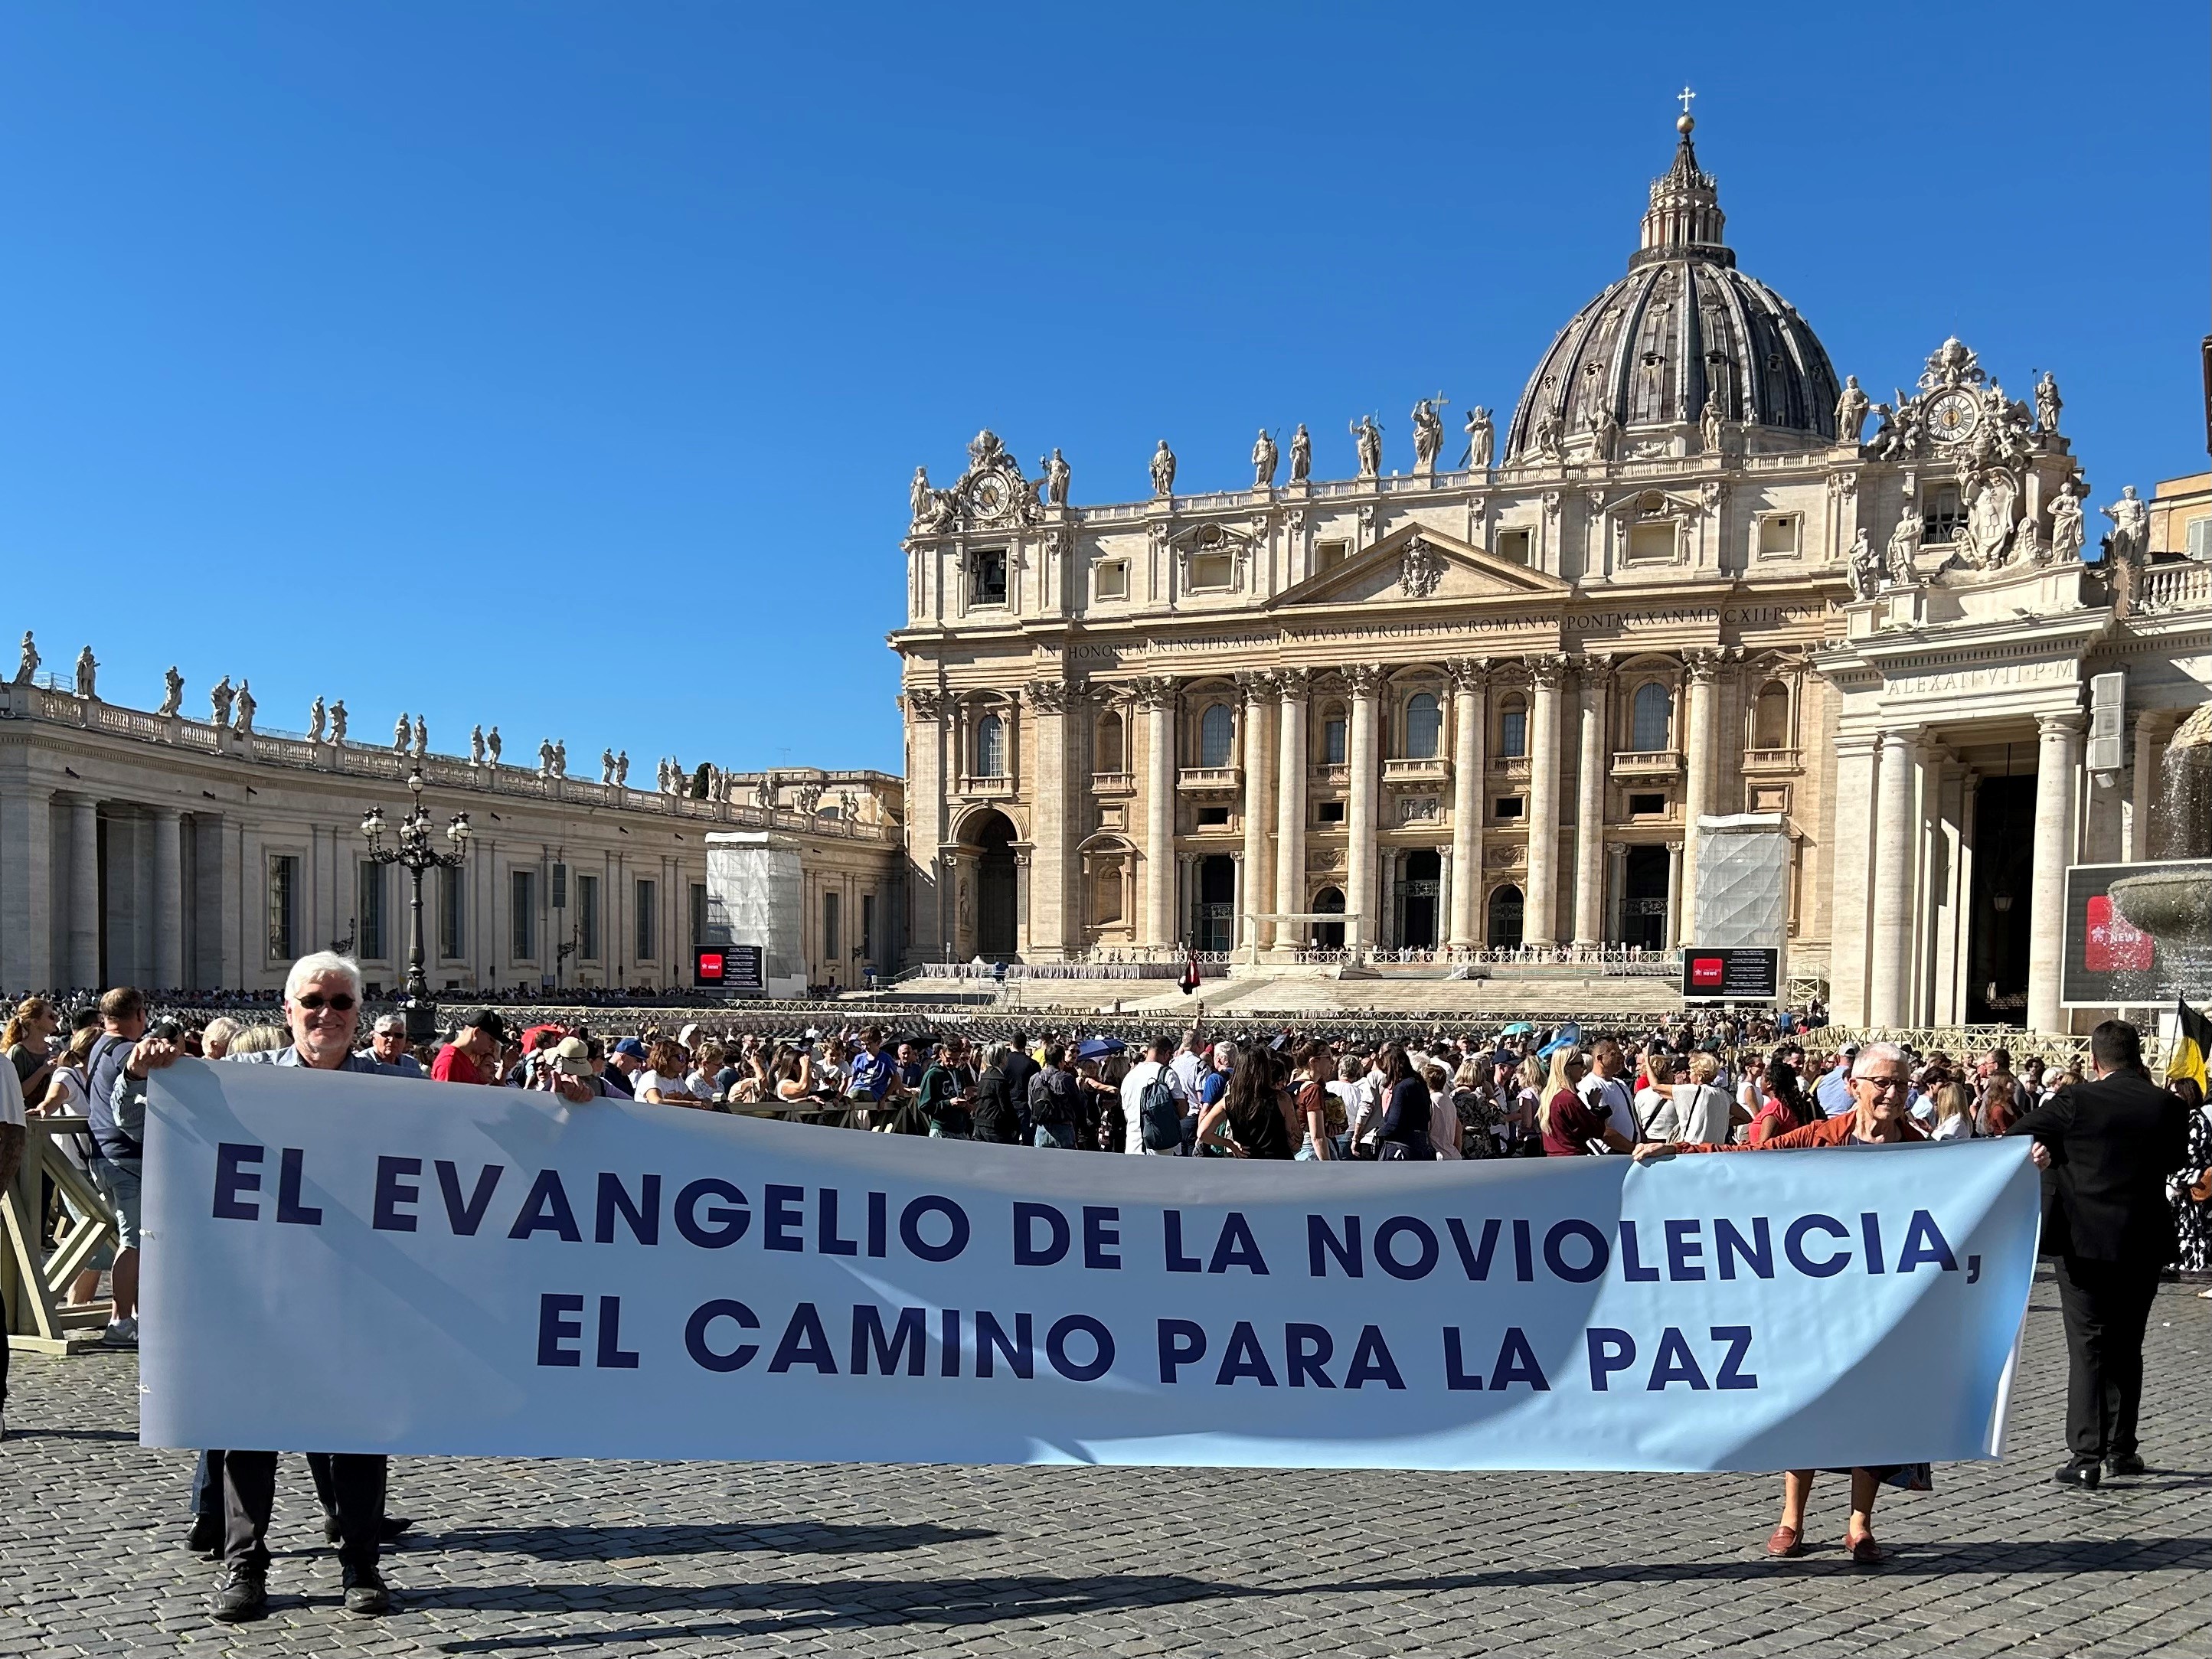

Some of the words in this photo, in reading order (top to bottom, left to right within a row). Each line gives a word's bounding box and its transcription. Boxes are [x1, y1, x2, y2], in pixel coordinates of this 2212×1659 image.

[1040, 645, 1057, 658] IN
[1069, 643, 1147, 659] HONOREM
[1148, 636, 1229, 653] PRINCIPIS
[1468, 615, 1560, 634] ROMANVS
[1773, 605, 1825, 620] PONT
[1887, 671, 1975, 695] ALEXAN
[1987, 665, 2023, 685] VII
[213, 1143, 322, 1225] EL
[373, 1156, 969, 1262] EVANGELIO
[1013, 1202, 1121, 1269] DE
[1164, 1210, 1269, 1275] LA
[1307, 1210, 1981, 1284] NOVIOLENCIA,
[537, 1294, 639, 1368] EL
[685, 1299, 1115, 1381] CAMINO
[1158, 1319, 1407, 1390] PARA
[1443, 1327, 1550, 1390] LA
[1586, 1326, 1758, 1391] PAZ
